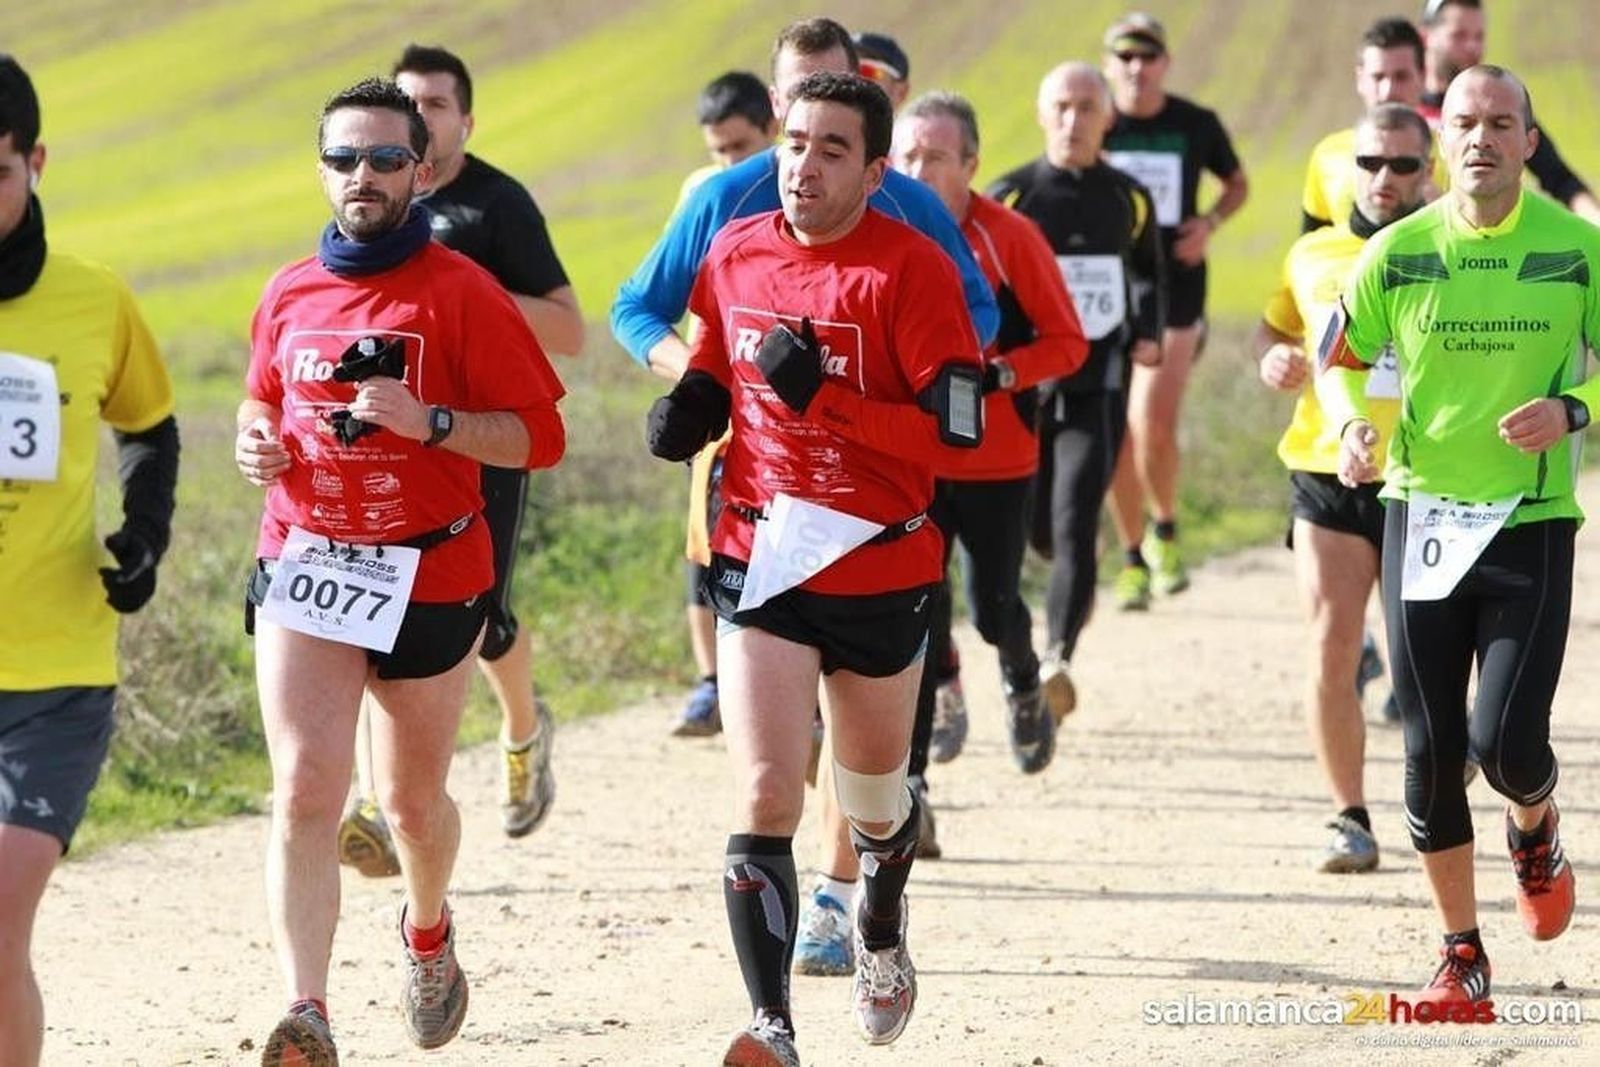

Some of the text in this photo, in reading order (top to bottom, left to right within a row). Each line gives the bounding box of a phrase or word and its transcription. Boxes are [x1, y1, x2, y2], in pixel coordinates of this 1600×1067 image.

[1457, 255, 1509, 272] Joma
[1417, 313, 1551, 335] Correcaminos
[1443, 337, 1515, 359] Carbajosa
[3, 416, 37, 459] 3
[288, 573, 392, 622] 0077
